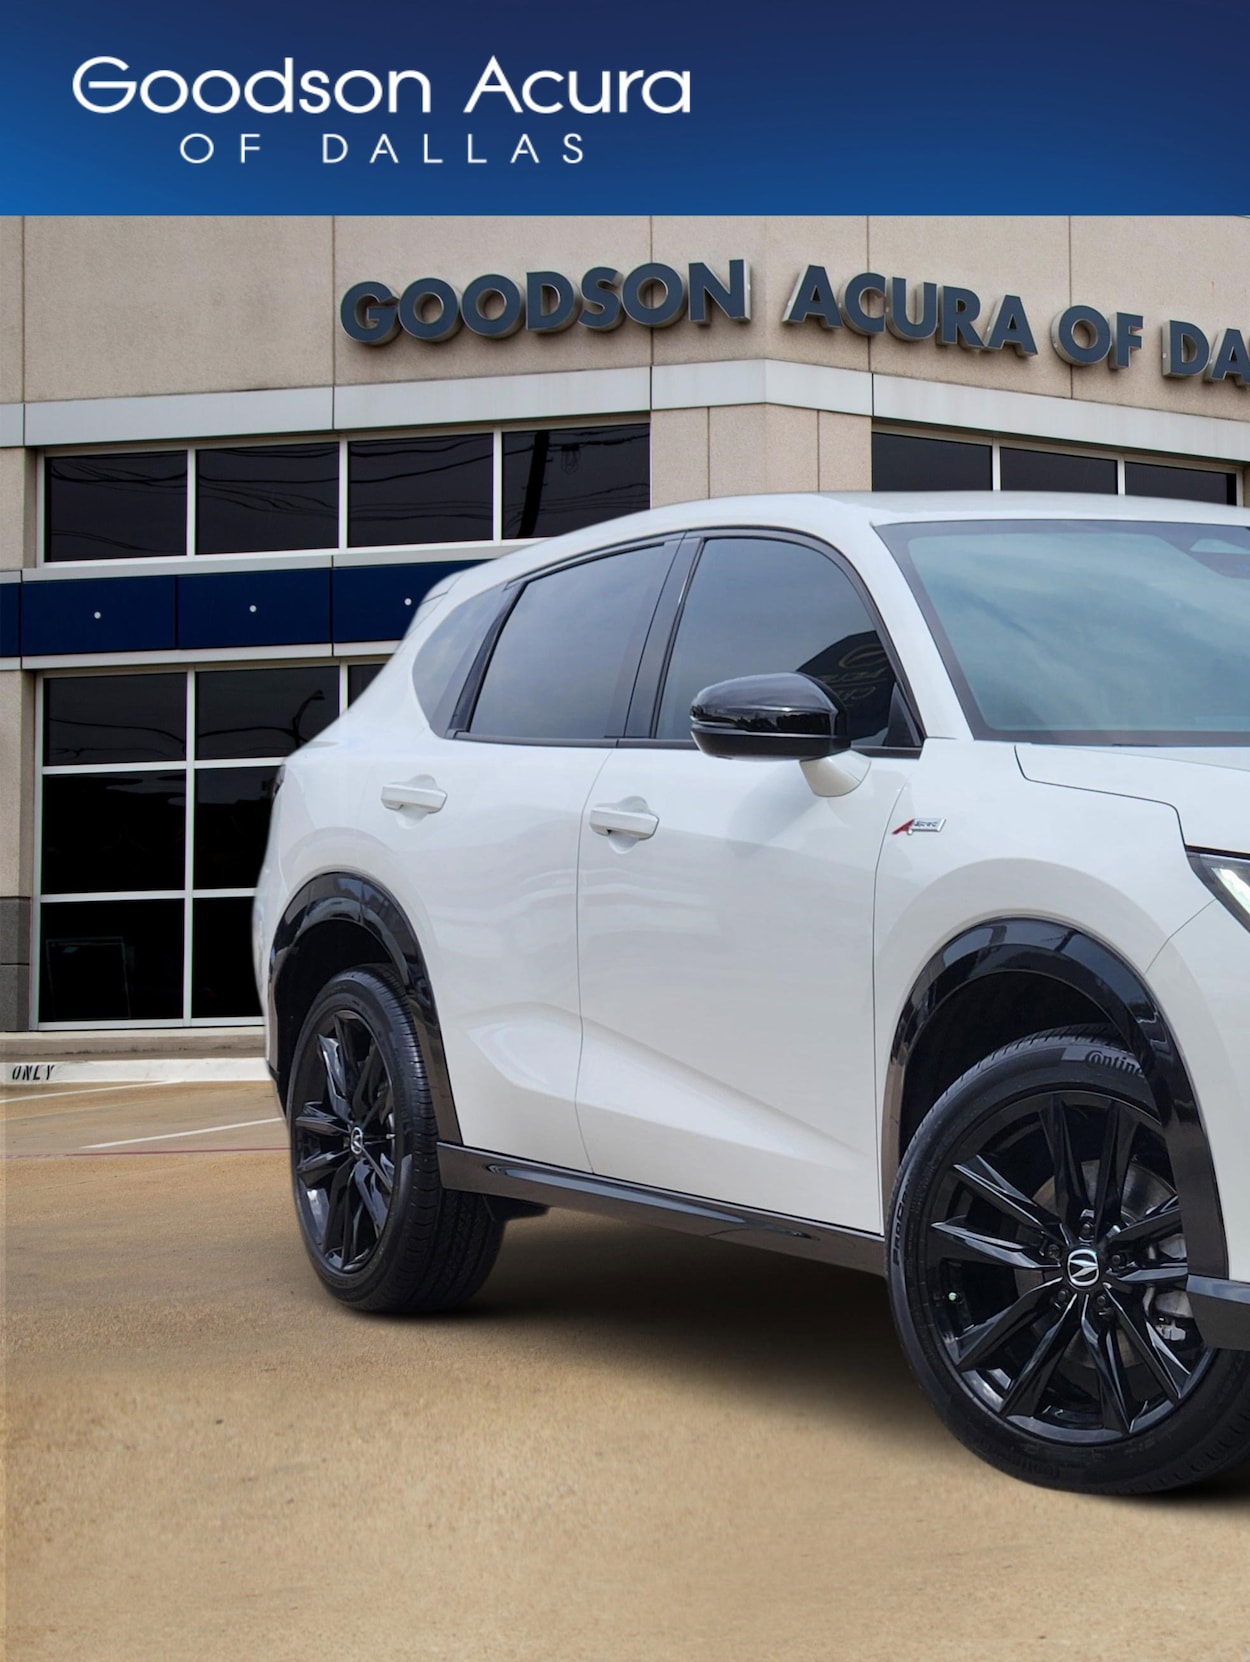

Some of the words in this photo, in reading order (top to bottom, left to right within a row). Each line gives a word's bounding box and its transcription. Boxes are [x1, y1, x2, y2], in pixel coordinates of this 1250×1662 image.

[340, 258, 751, 347] GOODSON
[782, 264, 1038, 356] ACURA
[1052, 304, 1144, 369] OF
[12, 1065, 55, 1081] ONLY
